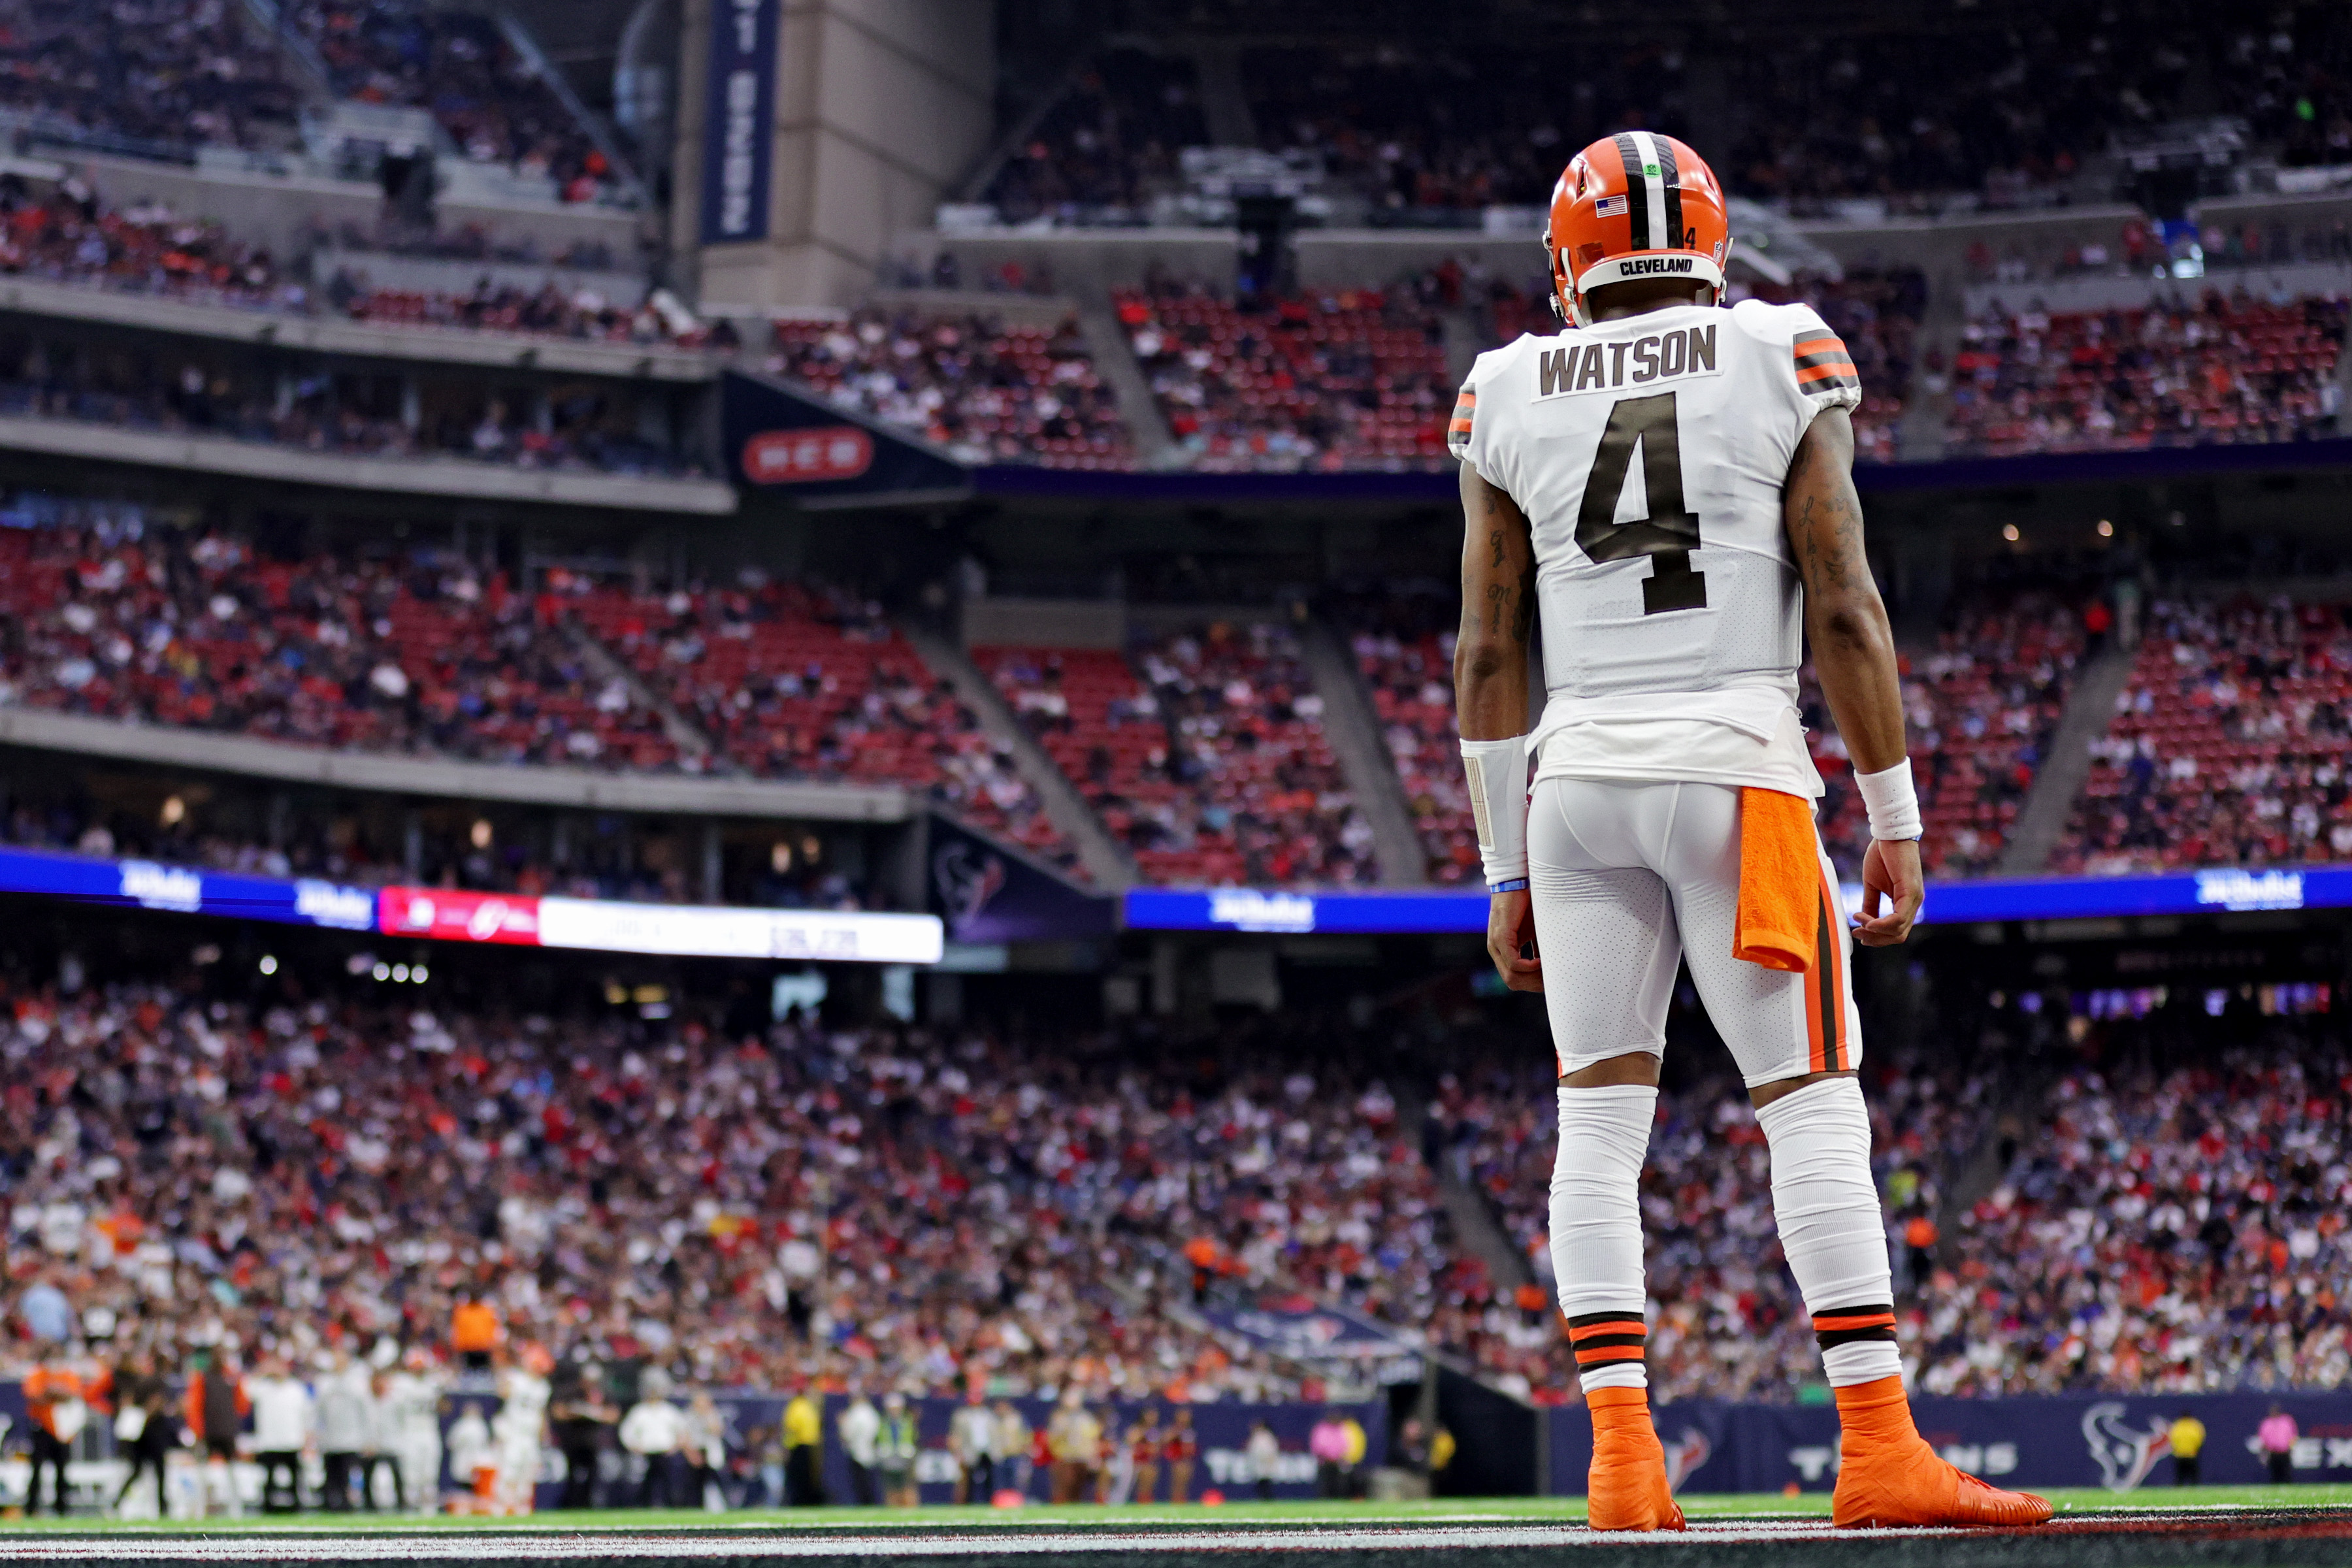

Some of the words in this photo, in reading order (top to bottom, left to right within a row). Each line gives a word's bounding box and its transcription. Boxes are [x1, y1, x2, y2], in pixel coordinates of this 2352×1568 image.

[1685, 227, 1696, 250] 4
[1620, 259, 1693, 276] CLEVELAND
[1540, 324, 1716, 396] WATSON
[1573, 391, 1707, 615] 4
